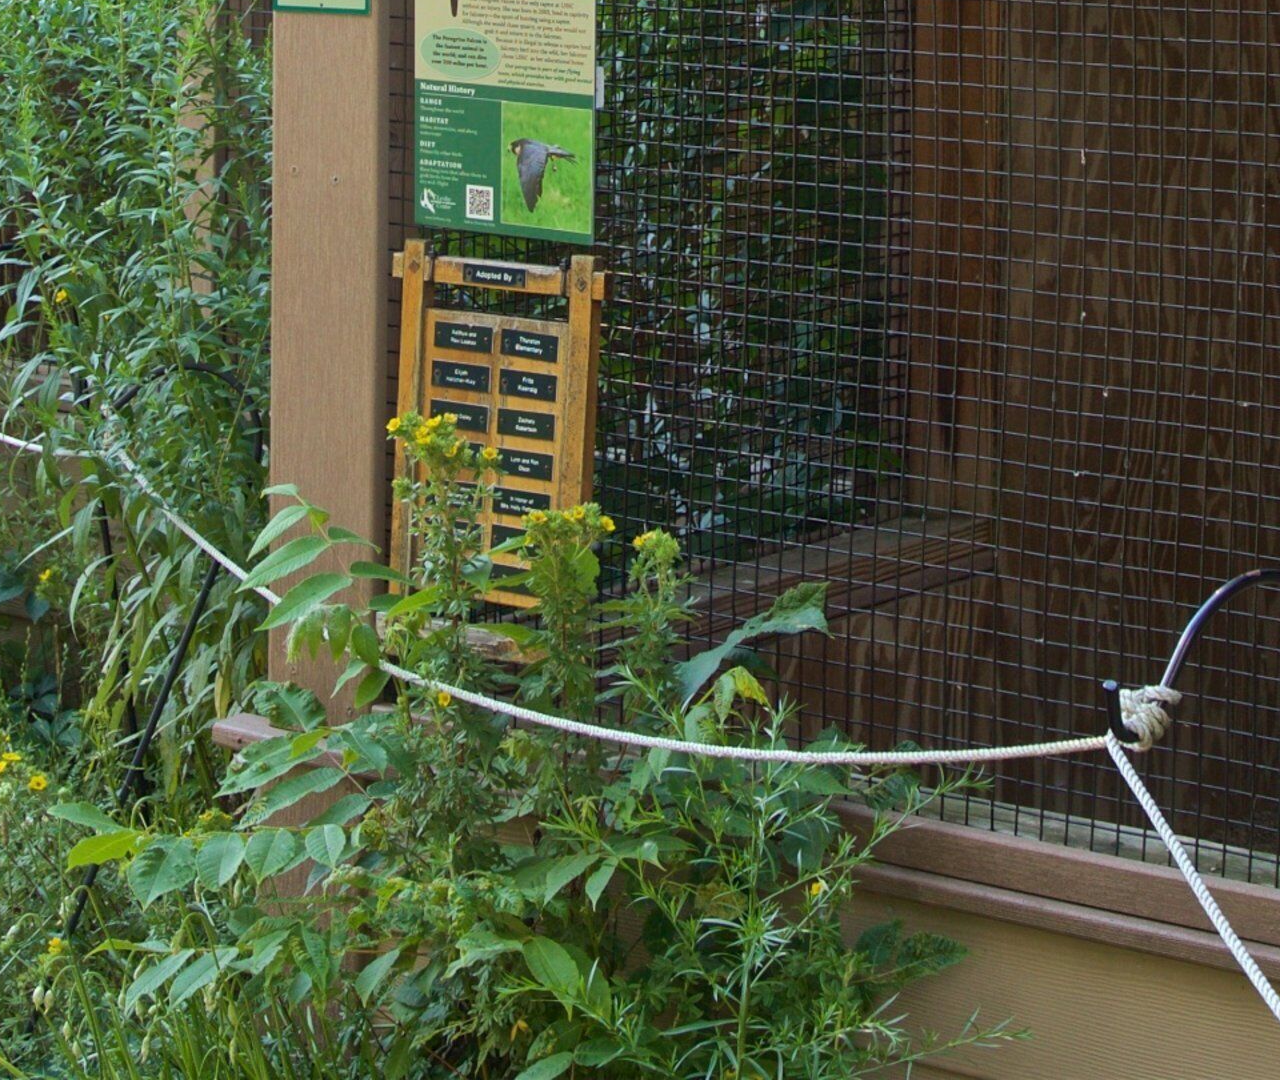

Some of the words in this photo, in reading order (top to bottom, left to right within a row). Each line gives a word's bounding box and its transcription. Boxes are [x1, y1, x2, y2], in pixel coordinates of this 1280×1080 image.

[420, 82, 447, 92] Natural
[448, 84, 475, 97] History
[420, 97, 442, 106] RANGE
[420, 115, 449, 125] HABITAT
[420, 140, 436, 148] DIET
[420, 158, 462, 169] ADAPTATION
[476, 270, 501, 280] Adopted
[503, 273, 513, 282] By
[515, 343, 543, 355] Elementary
